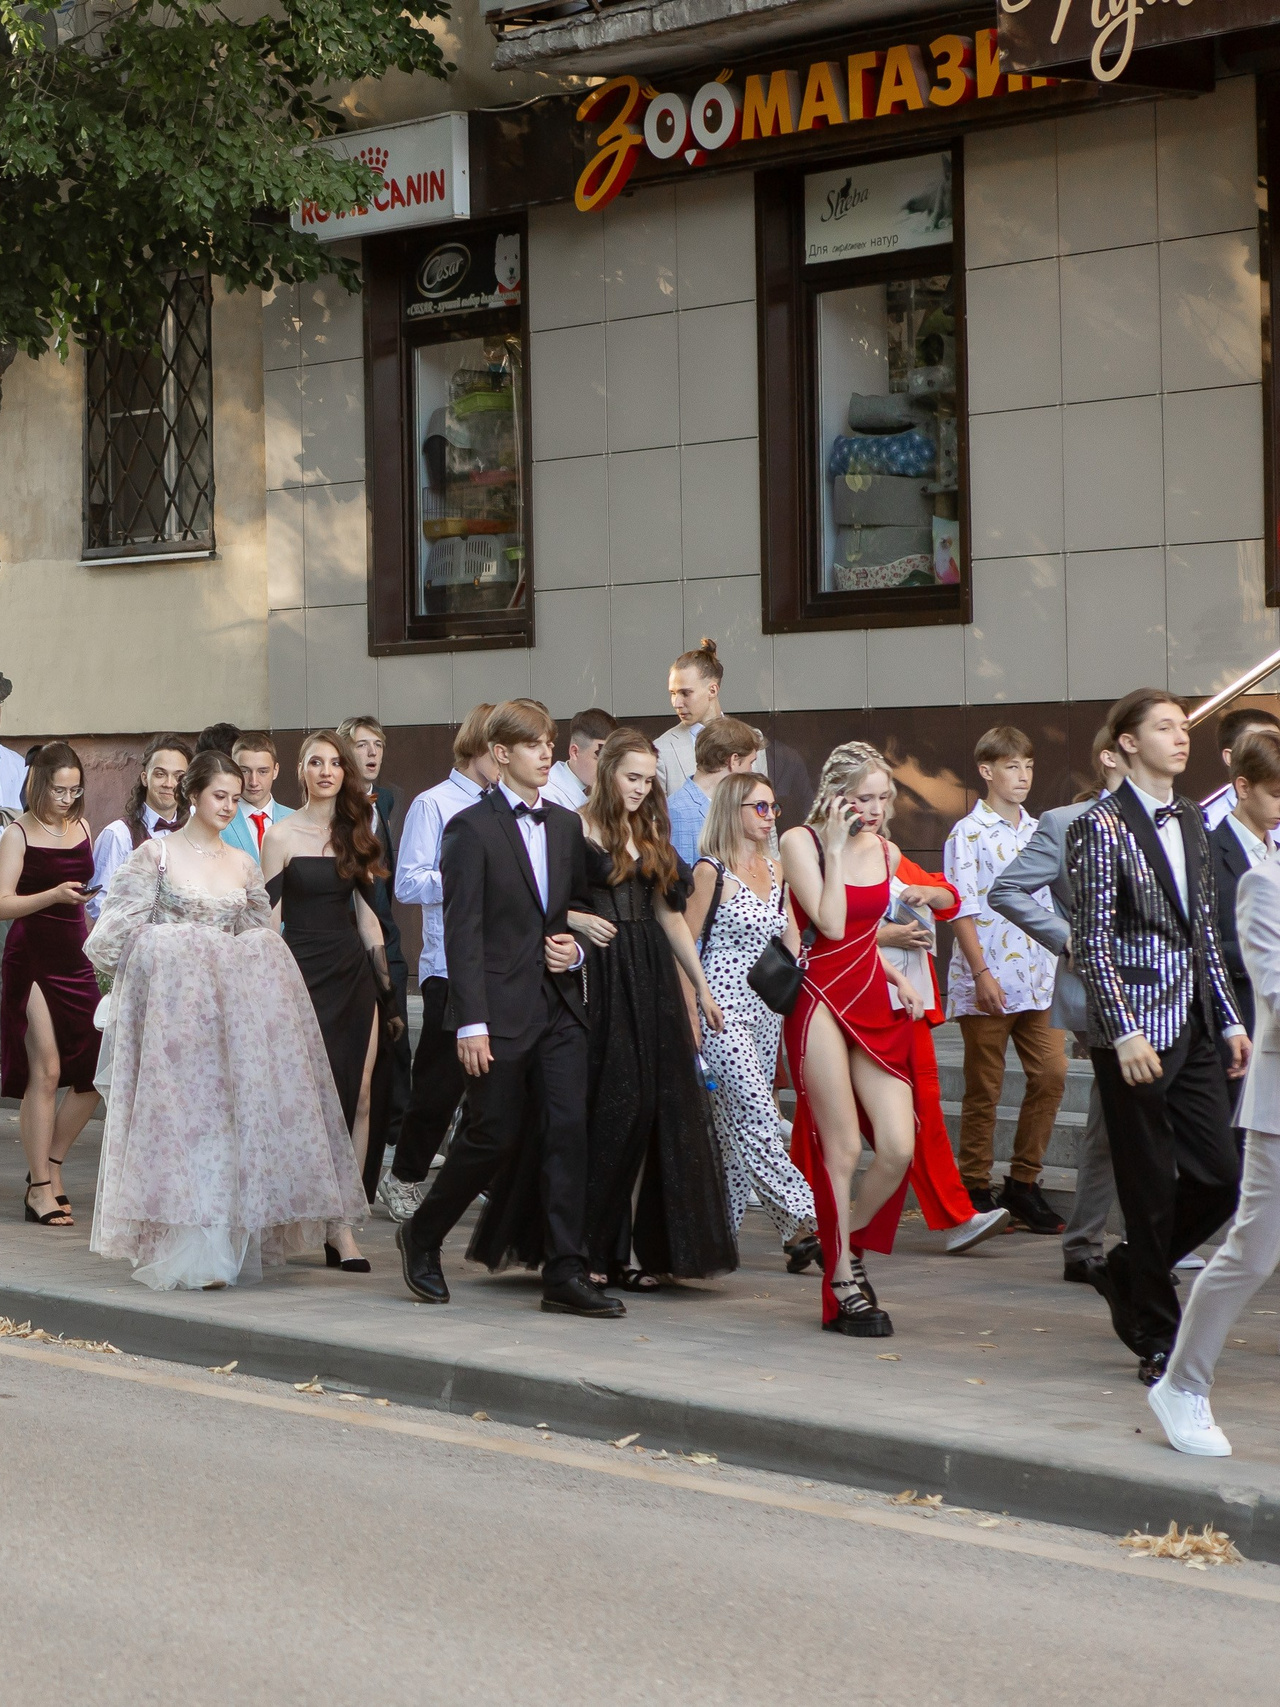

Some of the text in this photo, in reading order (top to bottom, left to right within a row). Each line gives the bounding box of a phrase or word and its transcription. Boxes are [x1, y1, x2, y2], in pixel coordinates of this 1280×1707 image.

[373, 169, 445, 212] CANIN
[820, 188, 869, 222] Sheba
[808, 244, 828, 258] Для
[870, 234, 899, 248] натур
[423, 255, 464, 288] Cesar
